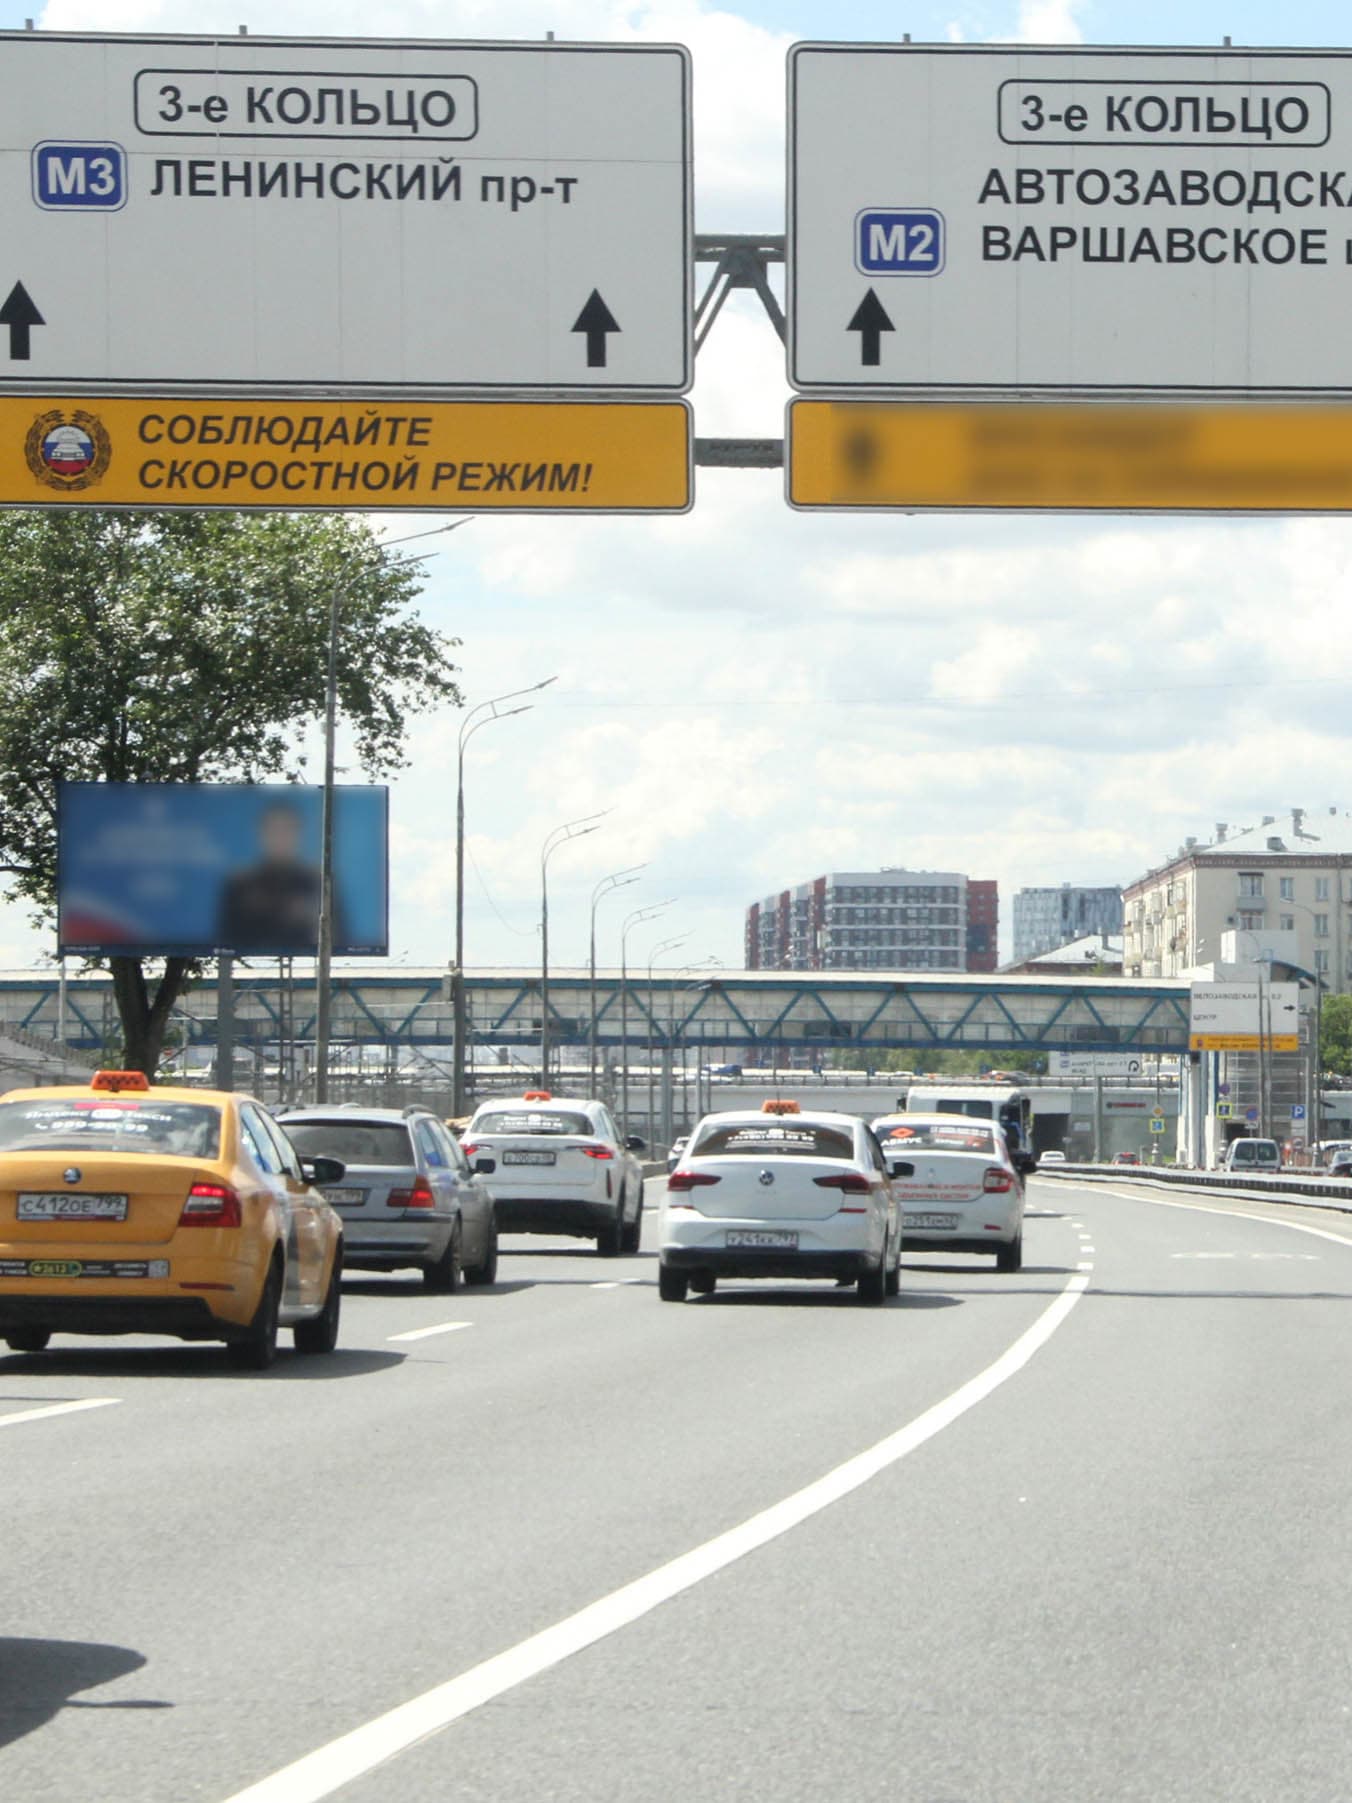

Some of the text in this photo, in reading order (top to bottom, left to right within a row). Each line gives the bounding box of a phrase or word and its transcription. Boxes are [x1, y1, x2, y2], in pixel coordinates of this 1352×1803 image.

[157, 85, 457, 135] 3-е КОЛЬЦО
[1019, 94, 1310, 141] 3-е КОЛЬЦО
[150, 157, 578, 212] ЛЕНИНСКИЙ пр-т
[981, 225, 1329, 266] ВАРШАВСКОЕ
[138, 409, 433, 453] СОБЛЮДАЙТЕ
[138, 455, 593, 493] СКОРОСТНОЙ РЕЖИМ!
